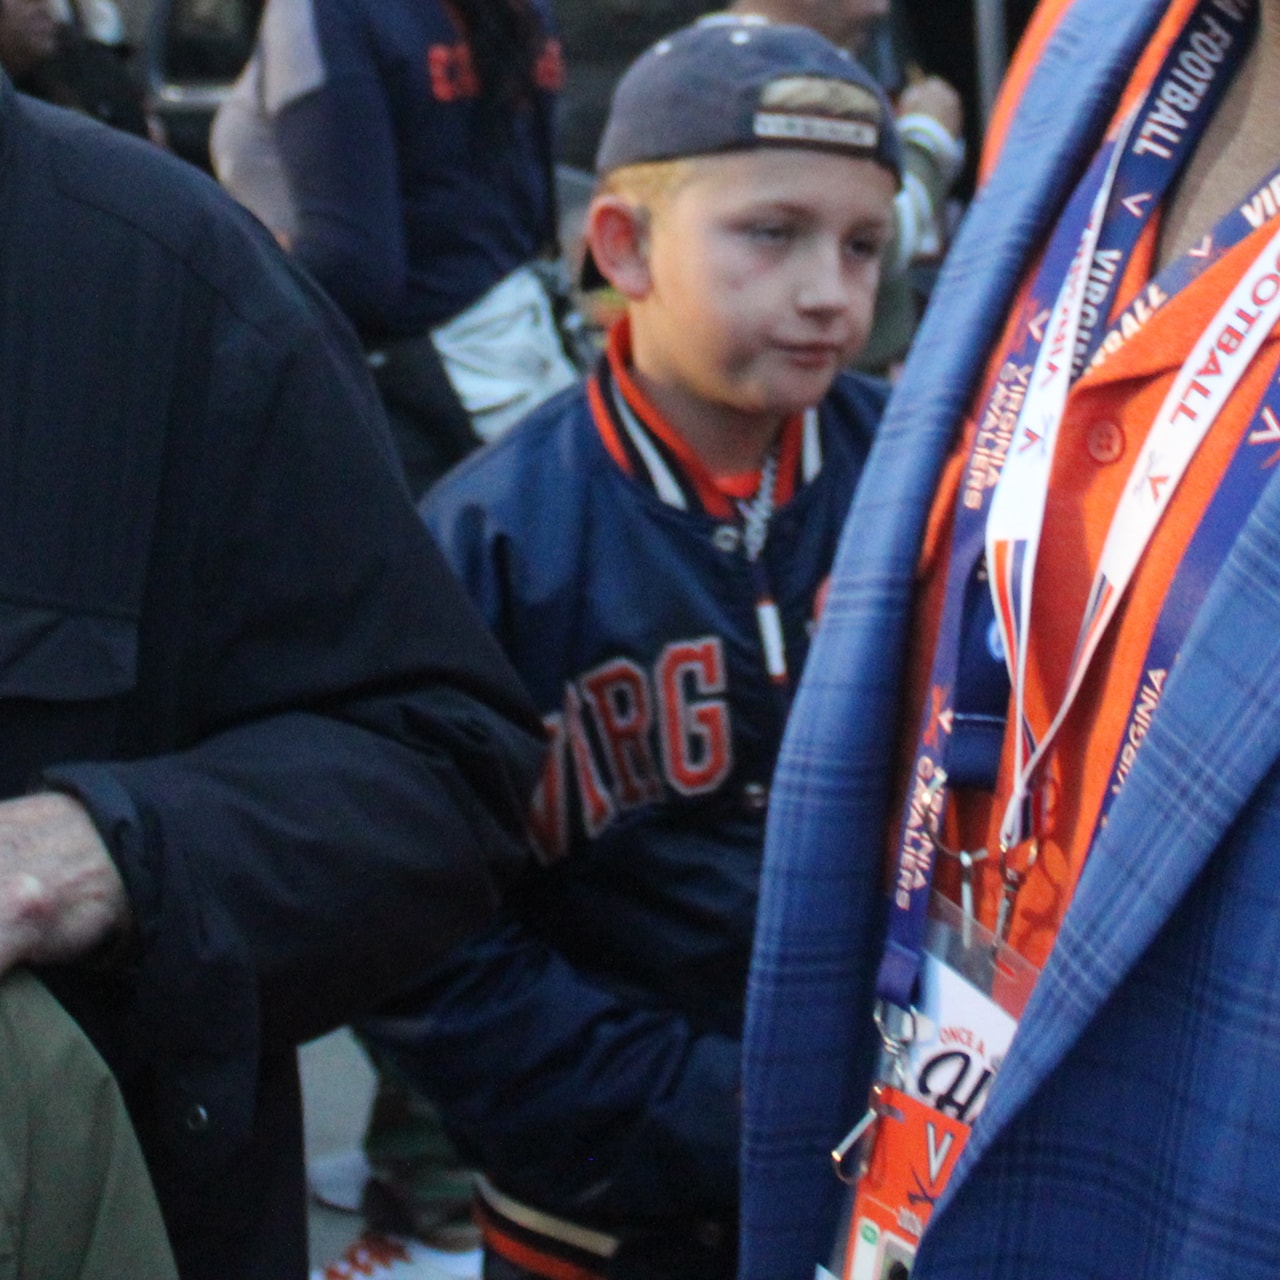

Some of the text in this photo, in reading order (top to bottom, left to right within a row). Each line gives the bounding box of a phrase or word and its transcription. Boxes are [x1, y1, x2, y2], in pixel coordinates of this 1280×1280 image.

[1131, 14, 1235, 160] FOOTBALL
[963, 360, 1020, 508] CAVALIERS
[983, 363, 1033, 488] VIRGINIA
[939, 1027, 986, 1057] ONCE A
